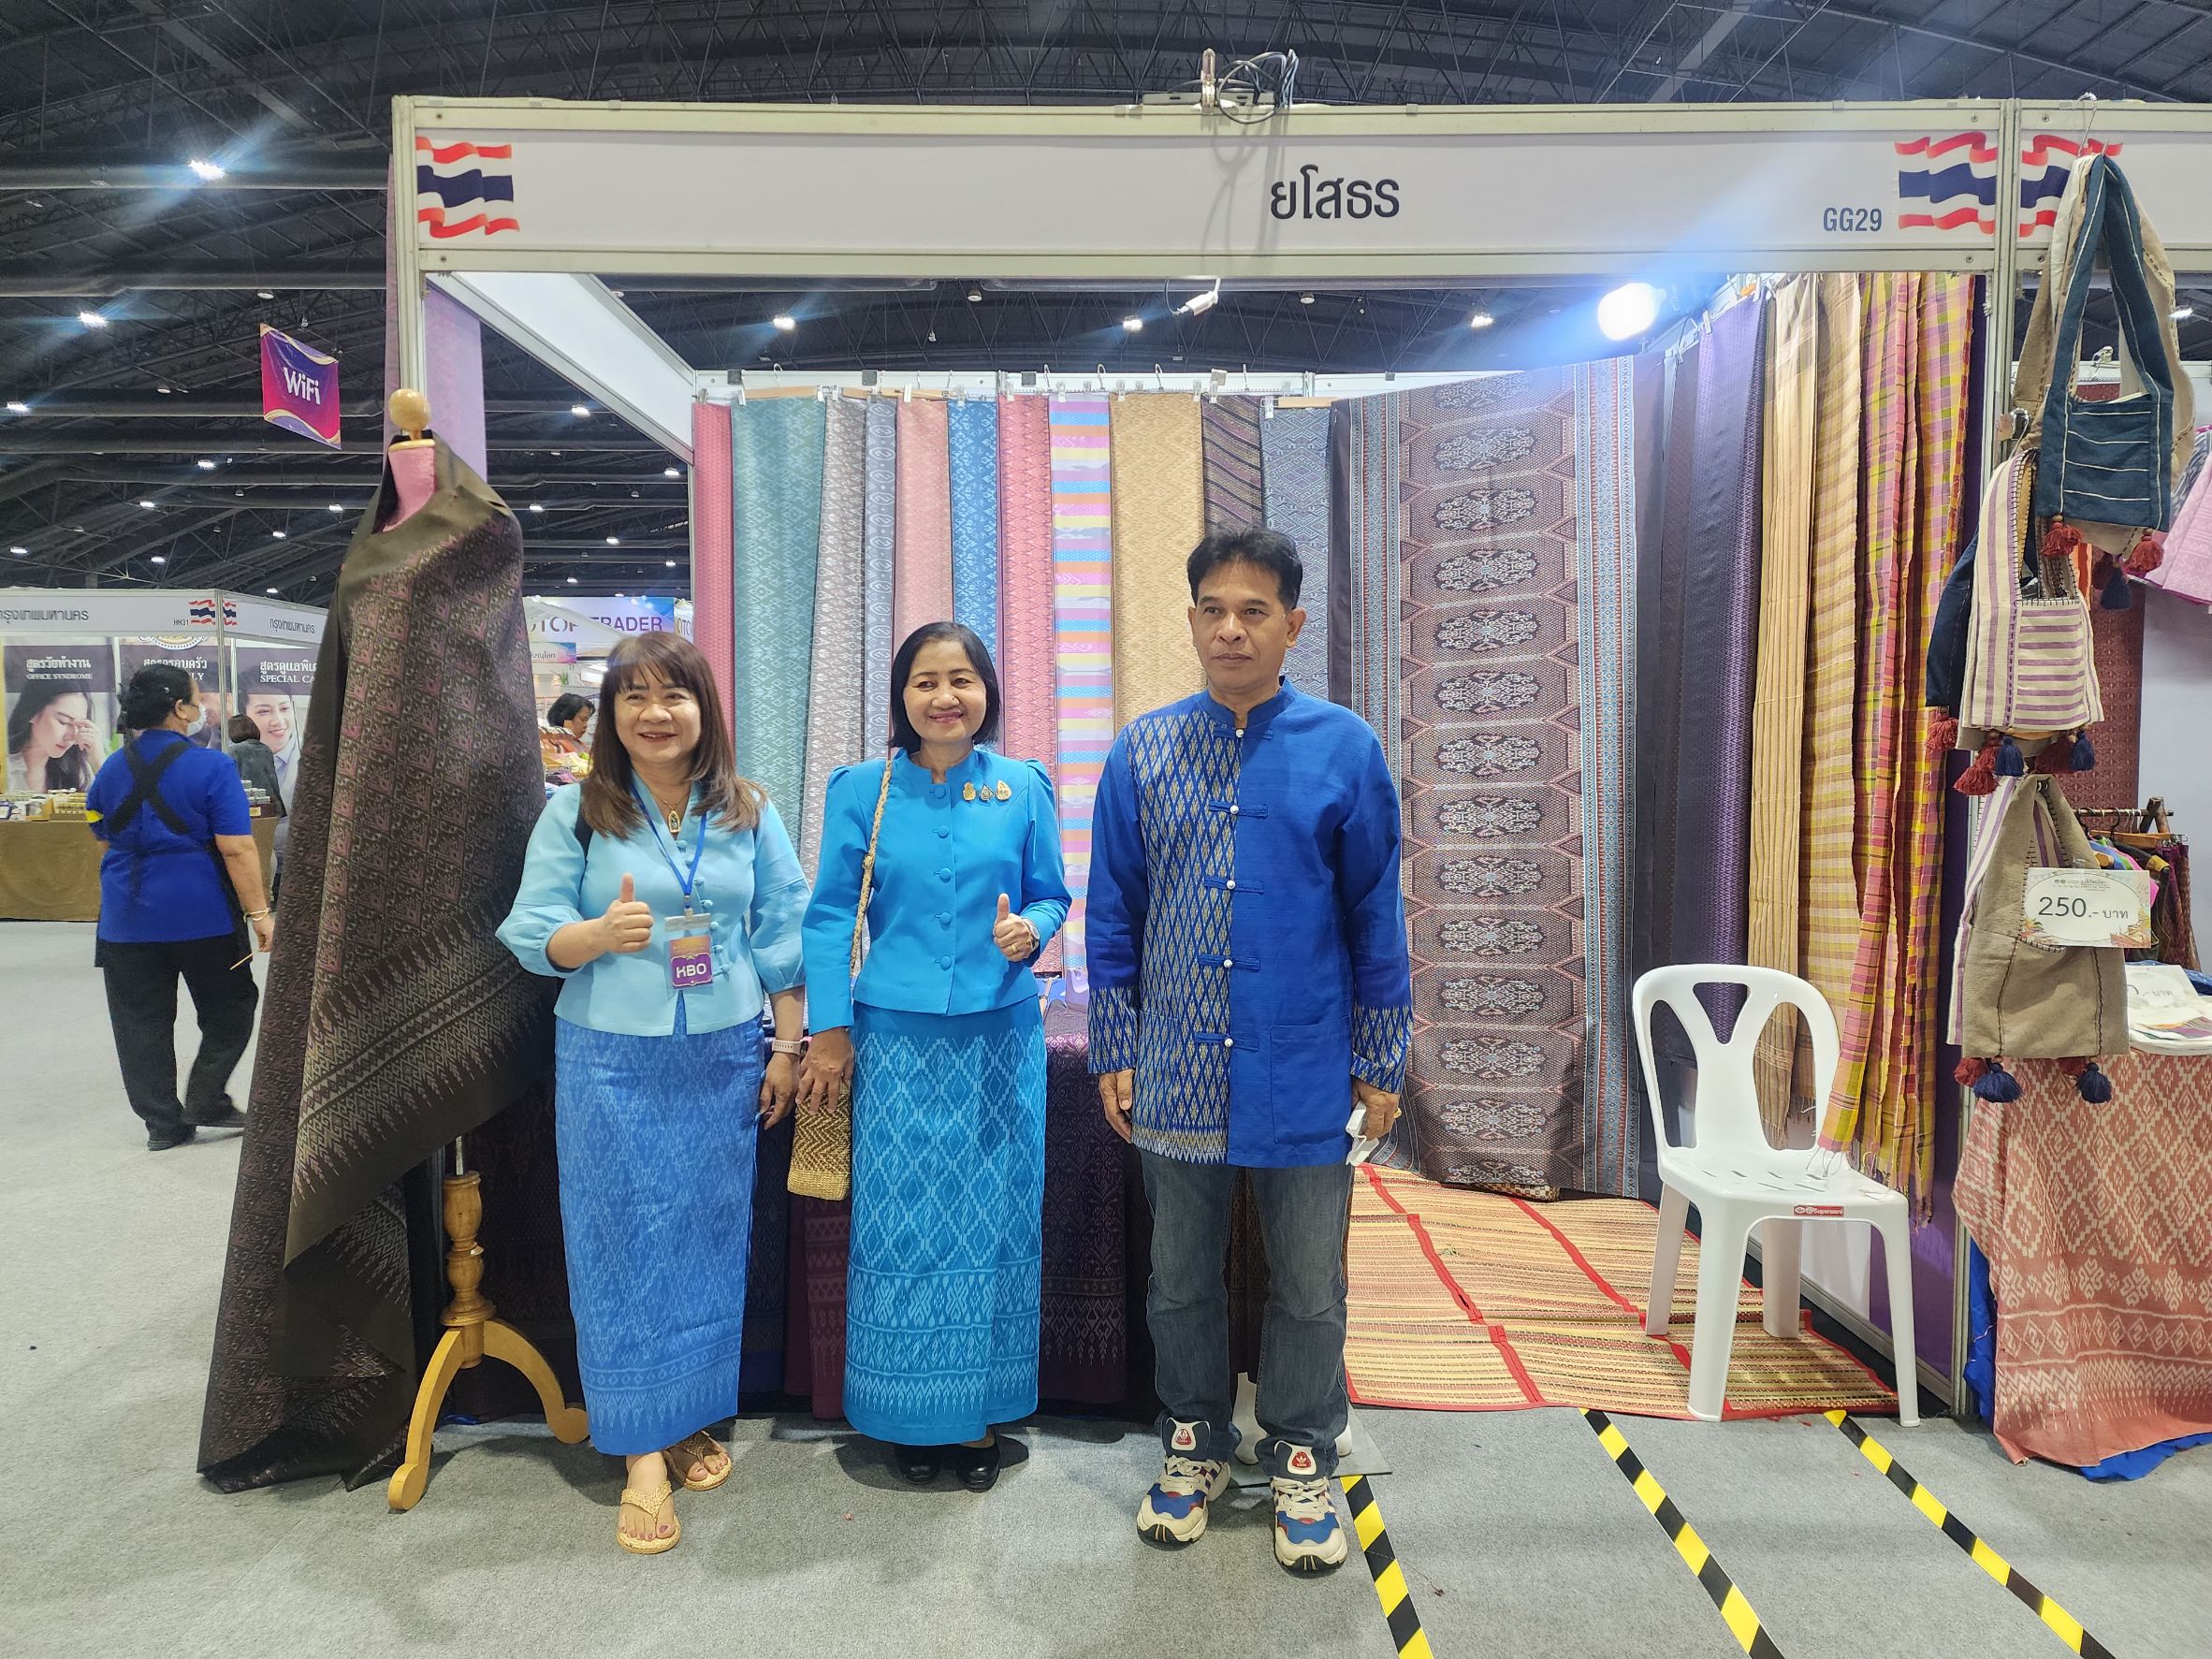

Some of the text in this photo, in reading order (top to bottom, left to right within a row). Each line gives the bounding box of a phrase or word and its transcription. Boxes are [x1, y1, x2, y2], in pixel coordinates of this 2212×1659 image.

[1271, 164, 1400, 220] ยโสธร
[1823, 207, 1883, 232] GG29
[283, 366, 321, 405] WiFi
[531, 615, 662, 633] TOP RADER
[259, 675, 299, 683] SPECIAL
[2038, 896, 2129, 919] 250.- บาท
[676, 963, 707, 979] KBO
